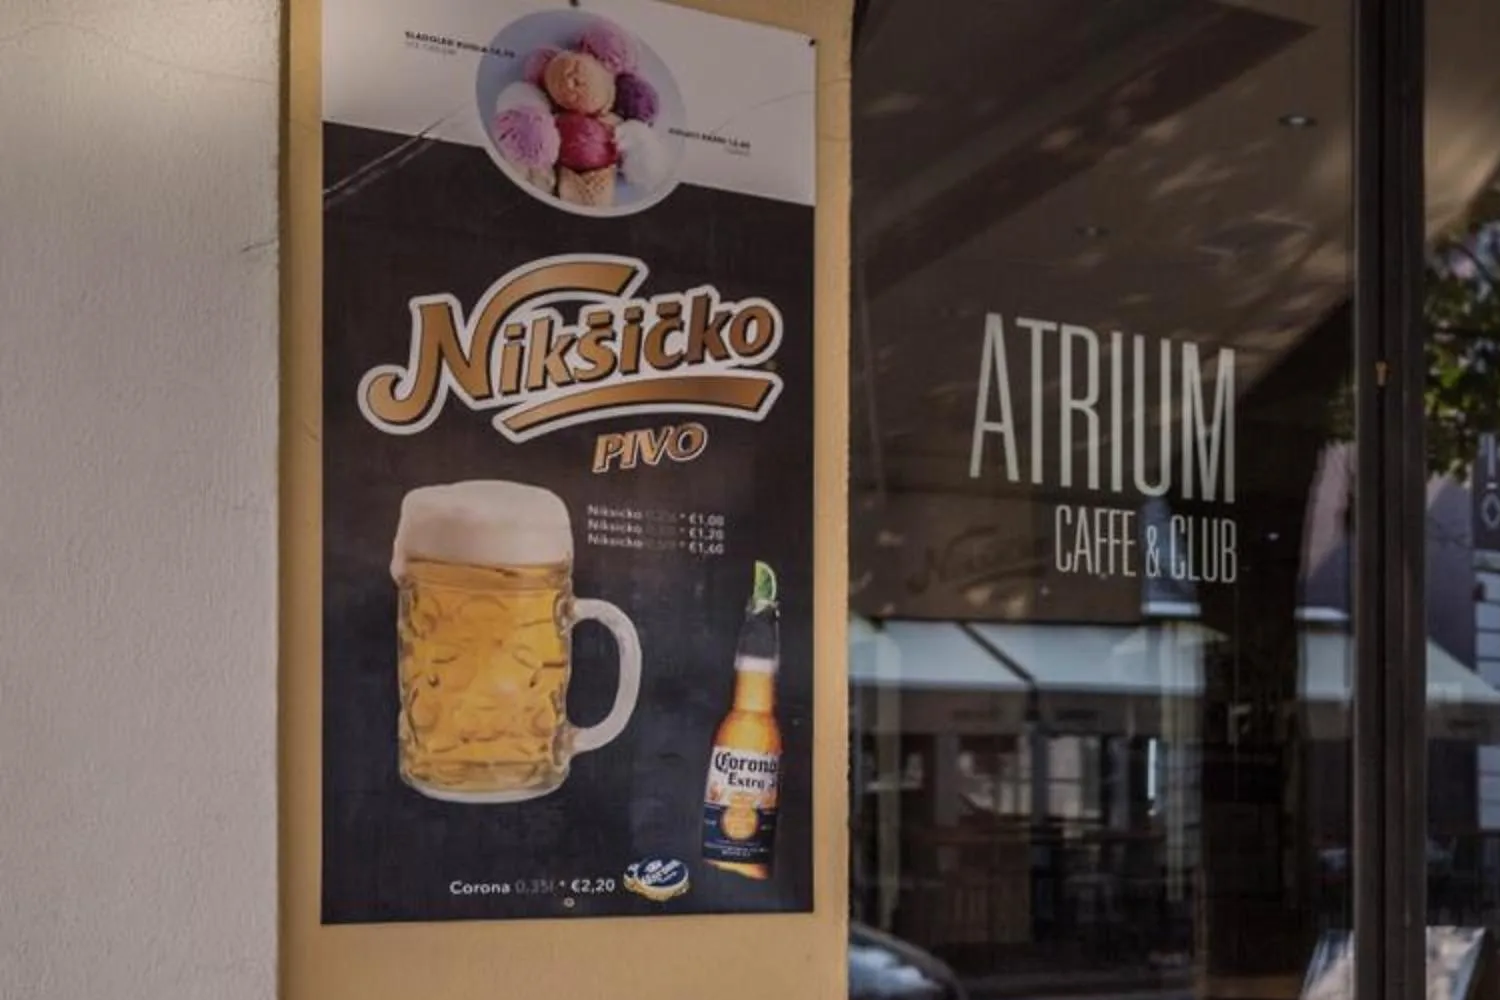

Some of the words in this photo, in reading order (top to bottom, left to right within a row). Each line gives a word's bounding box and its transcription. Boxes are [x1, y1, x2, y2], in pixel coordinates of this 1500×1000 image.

[969, 312, 1236, 504] ATRIUM
[592, 422, 708, 474] PIVO
[1055, 504, 1137, 578] CAFFE
[1145, 525, 1163, 579] &
[1169, 514, 1238, 584] CLUB
[450, 880, 511, 895] Corona
[571, 878, 616, 895] €2,20
